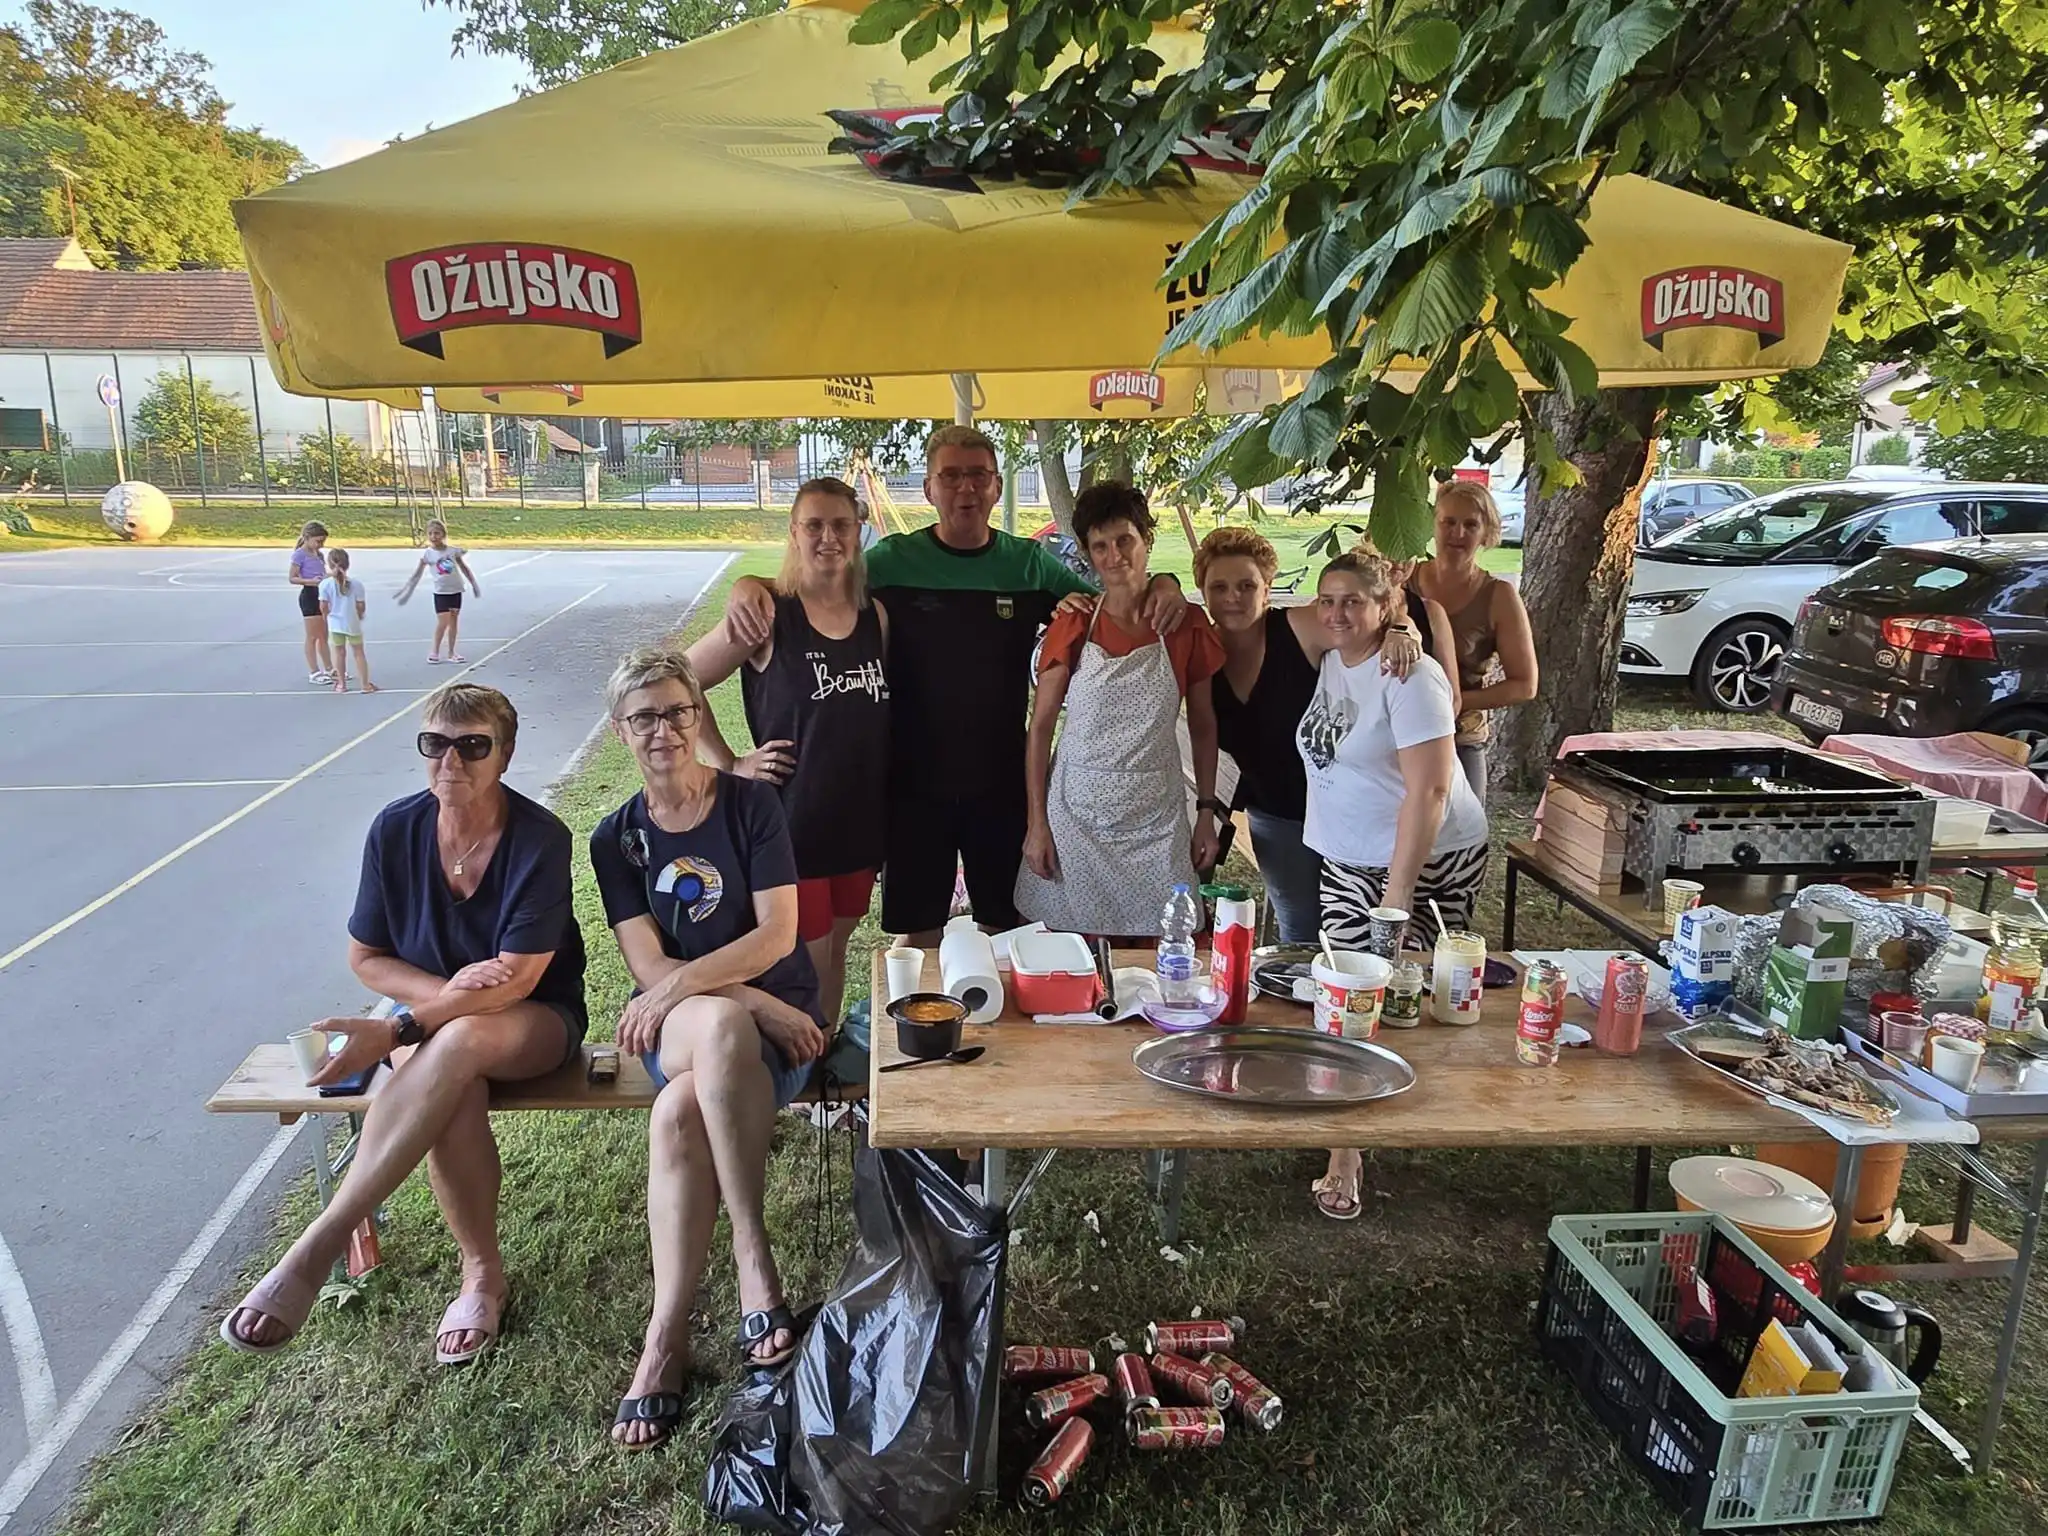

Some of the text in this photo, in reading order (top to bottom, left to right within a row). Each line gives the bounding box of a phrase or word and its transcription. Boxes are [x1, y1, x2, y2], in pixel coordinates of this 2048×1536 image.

[411, 249, 620, 322] Ožujsko
[1653, 271, 1771, 325] Ožujsko
[811, 659, 888, 702] Beautiful
[1878, 653, 1893, 665] HR
[1701, 950, 1732, 959] ALPSKO
